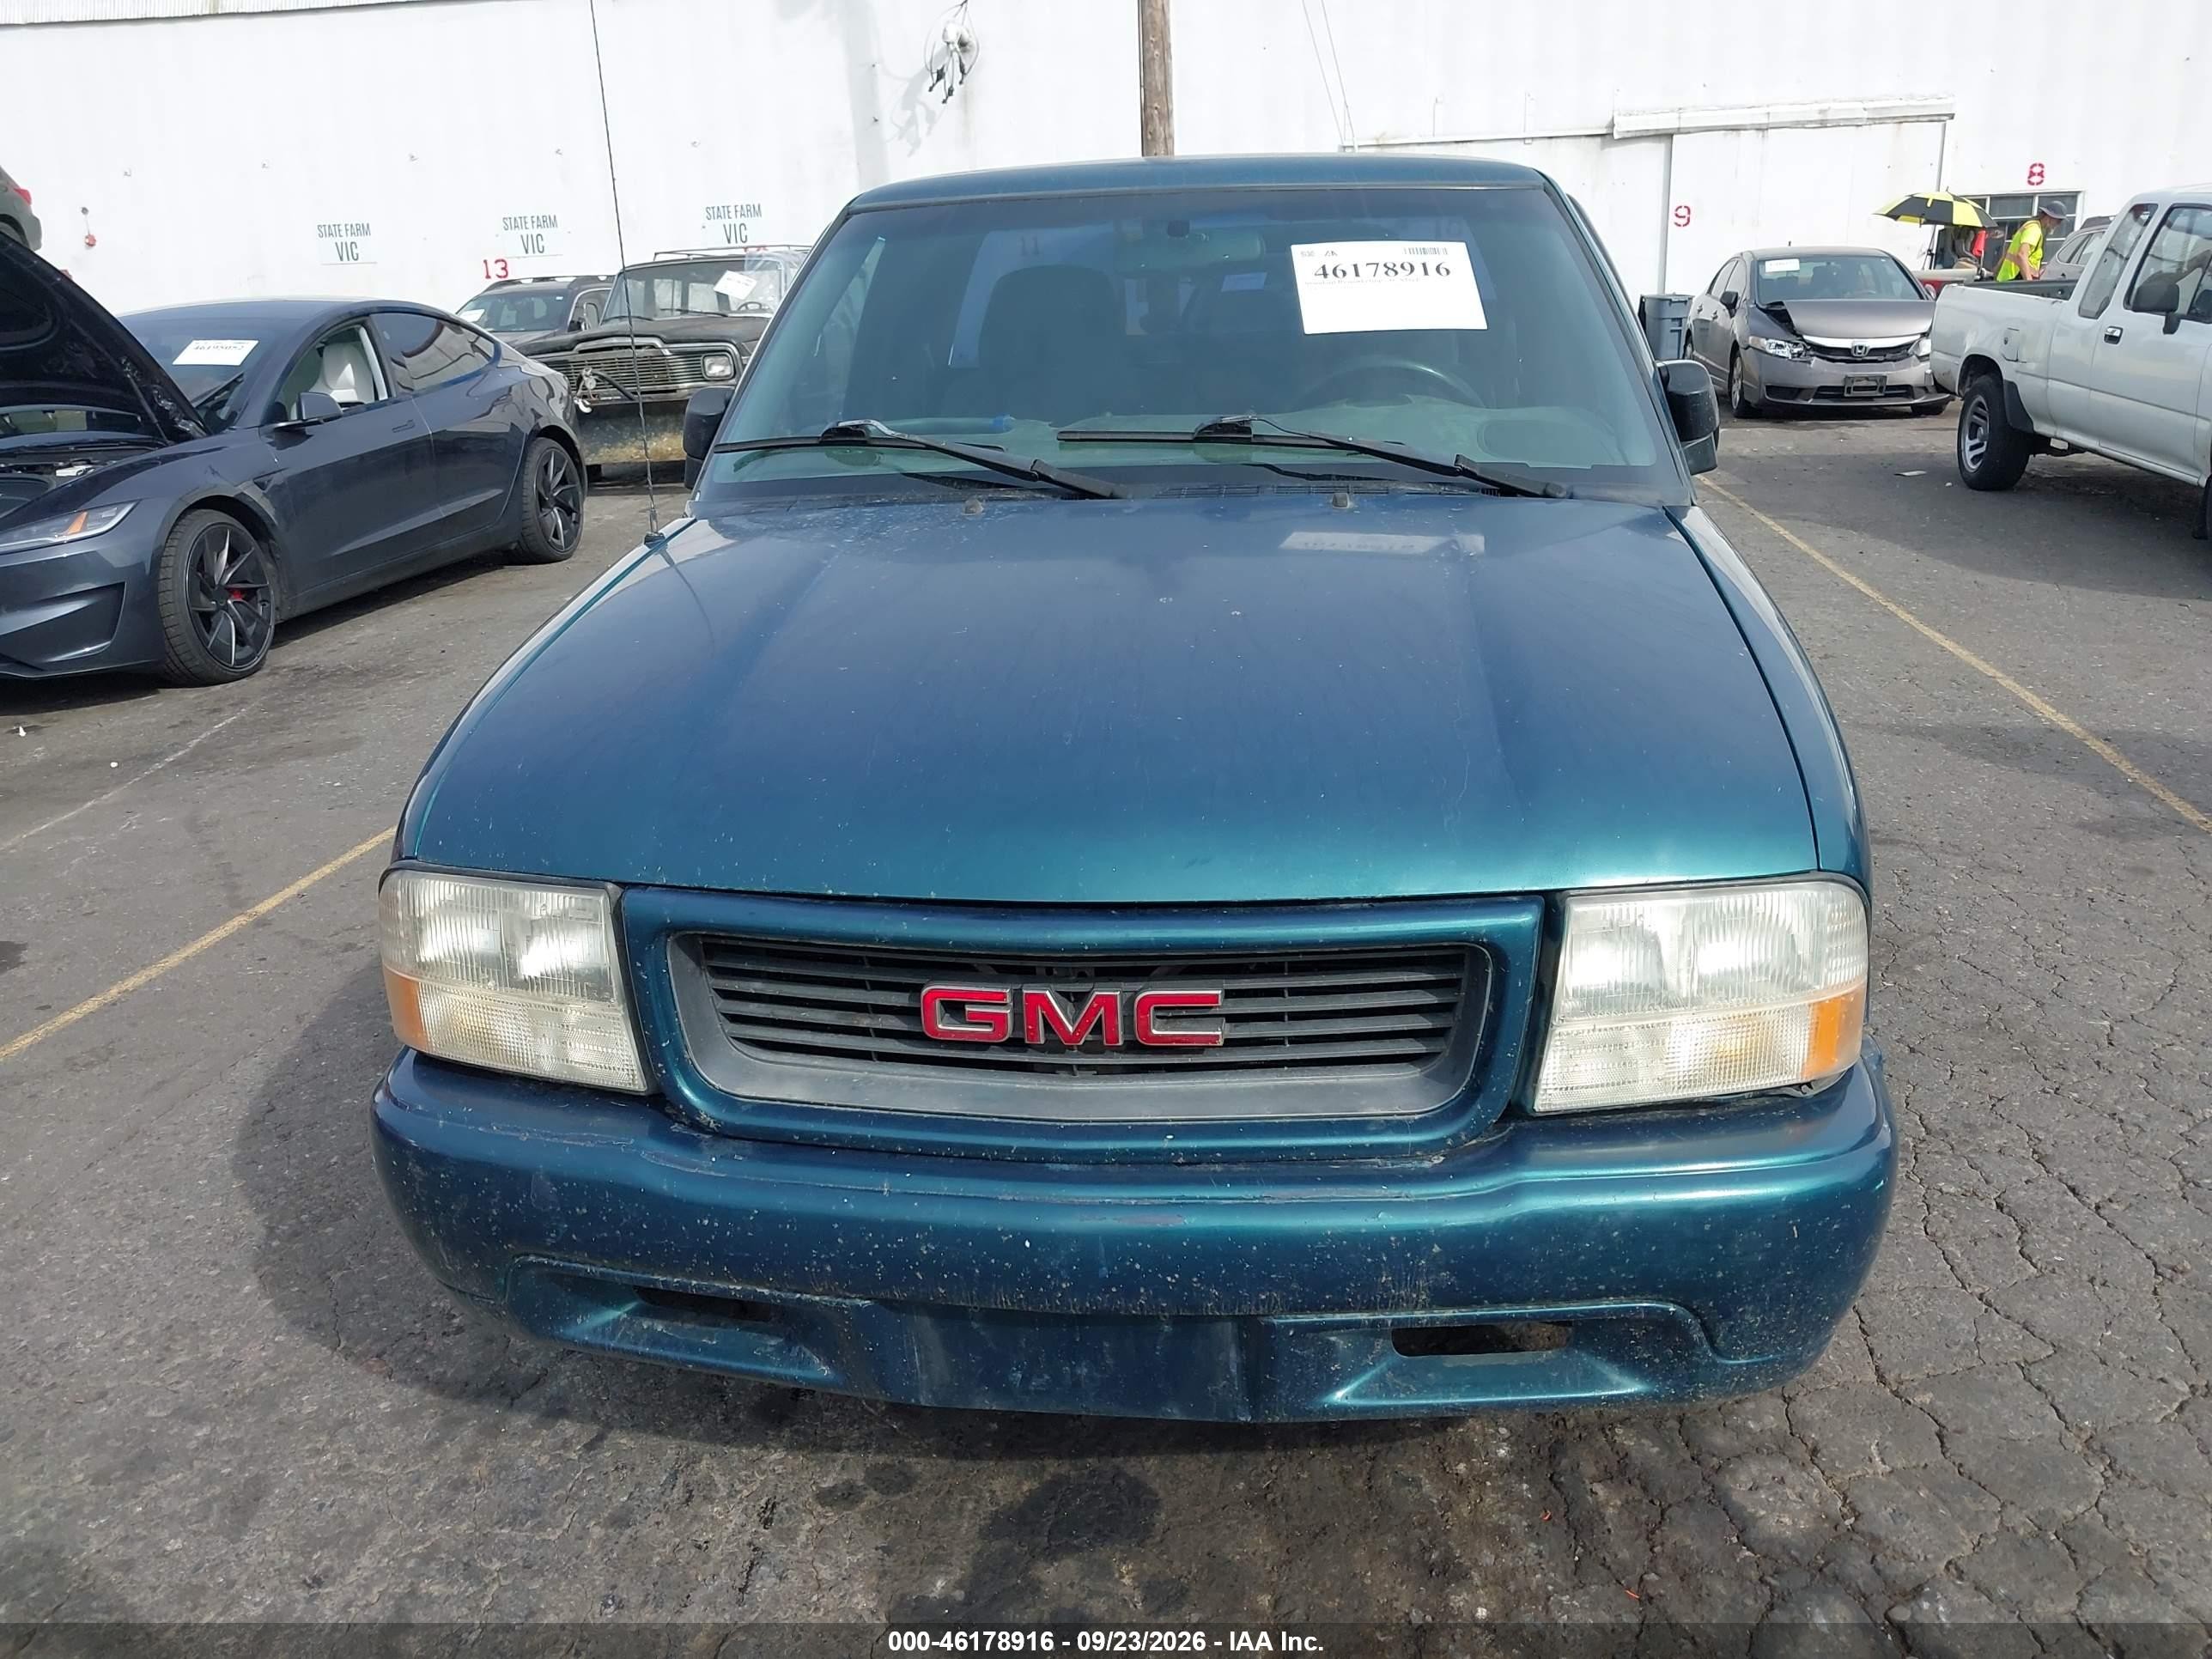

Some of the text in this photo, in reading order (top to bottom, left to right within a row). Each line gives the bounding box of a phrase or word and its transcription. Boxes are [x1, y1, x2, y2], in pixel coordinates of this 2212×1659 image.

[2027, 162, 2045, 185] 8
[502, 215, 558, 231] STATE FARM
[705, 204, 762, 221] STATE FARM
[1674, 205, 1691, 228] 9
[317, 222, 371, 238] STATE FARM
[724, 222, 748, 244] VIC
[335, 241, 359, 262] VIC
[520, 234, 545, 254] VIC
[483, 258, 509, 279] 13
[1314, 261, 1451, 279] 46178916
[921, 984, 1224, 1046] GMC
